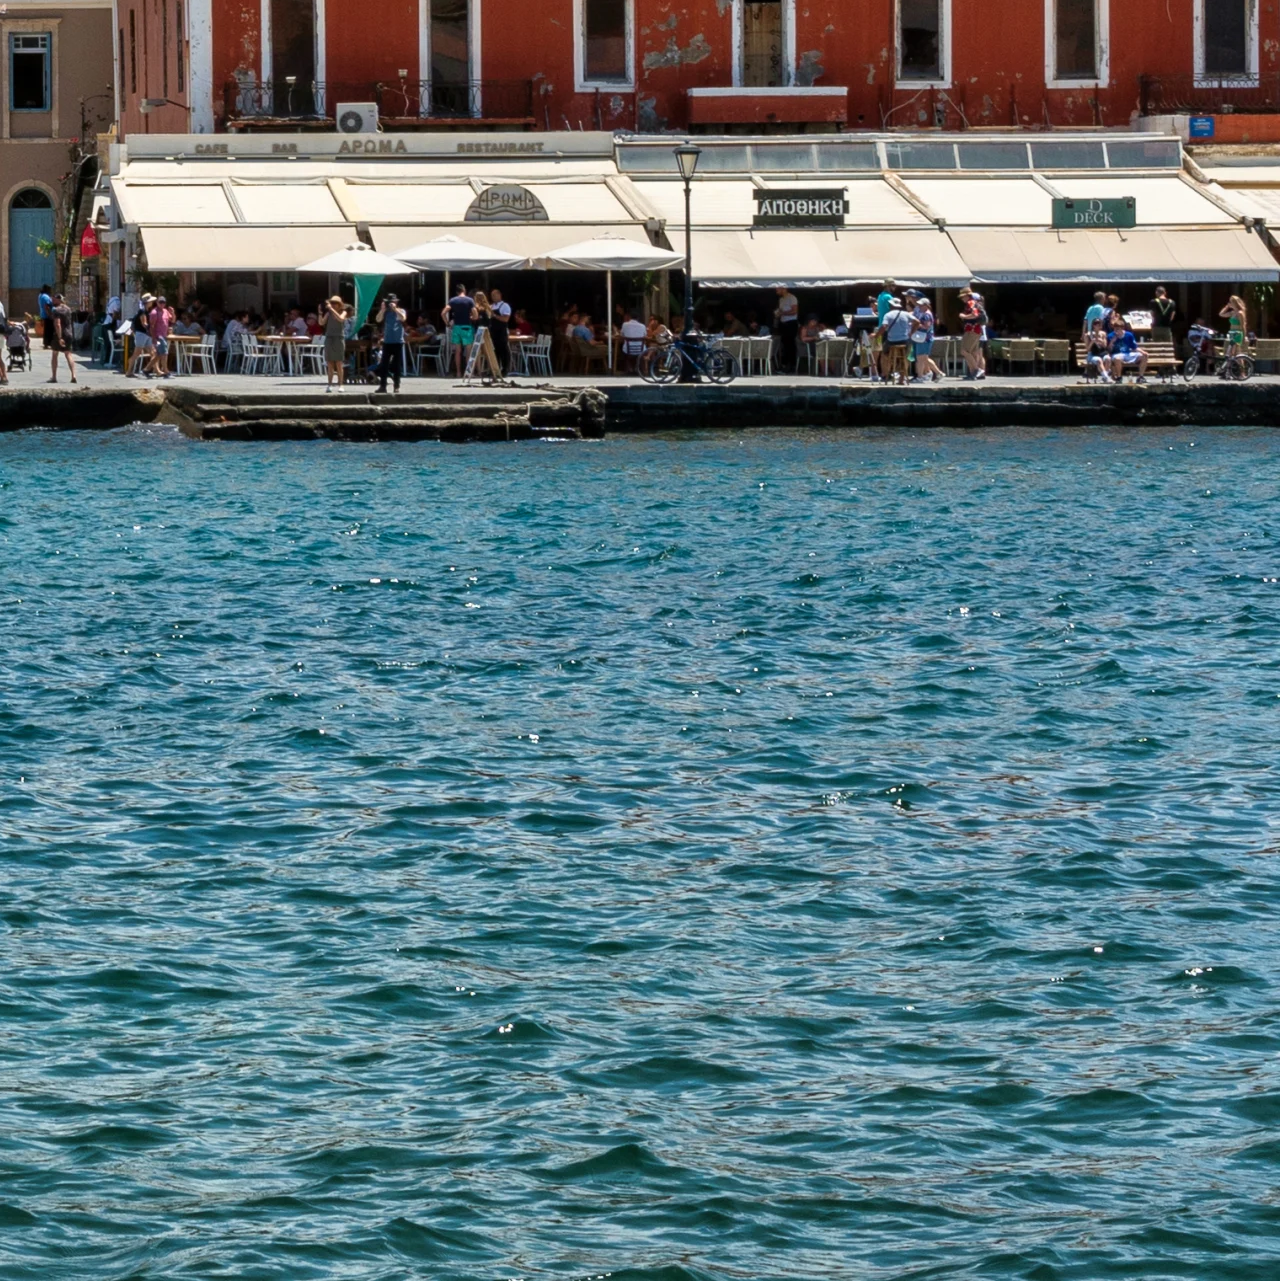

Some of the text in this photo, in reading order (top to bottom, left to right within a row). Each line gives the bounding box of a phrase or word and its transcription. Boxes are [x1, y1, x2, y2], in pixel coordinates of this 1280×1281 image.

[195, 143, 298, 153] CAFE BAR
[457, 142, 545, 152] RESTAURANT
[759, 199, 844, 215] ΑΠΟΘΗΚΗ
[1074, 212, 1114, 224] DECK
